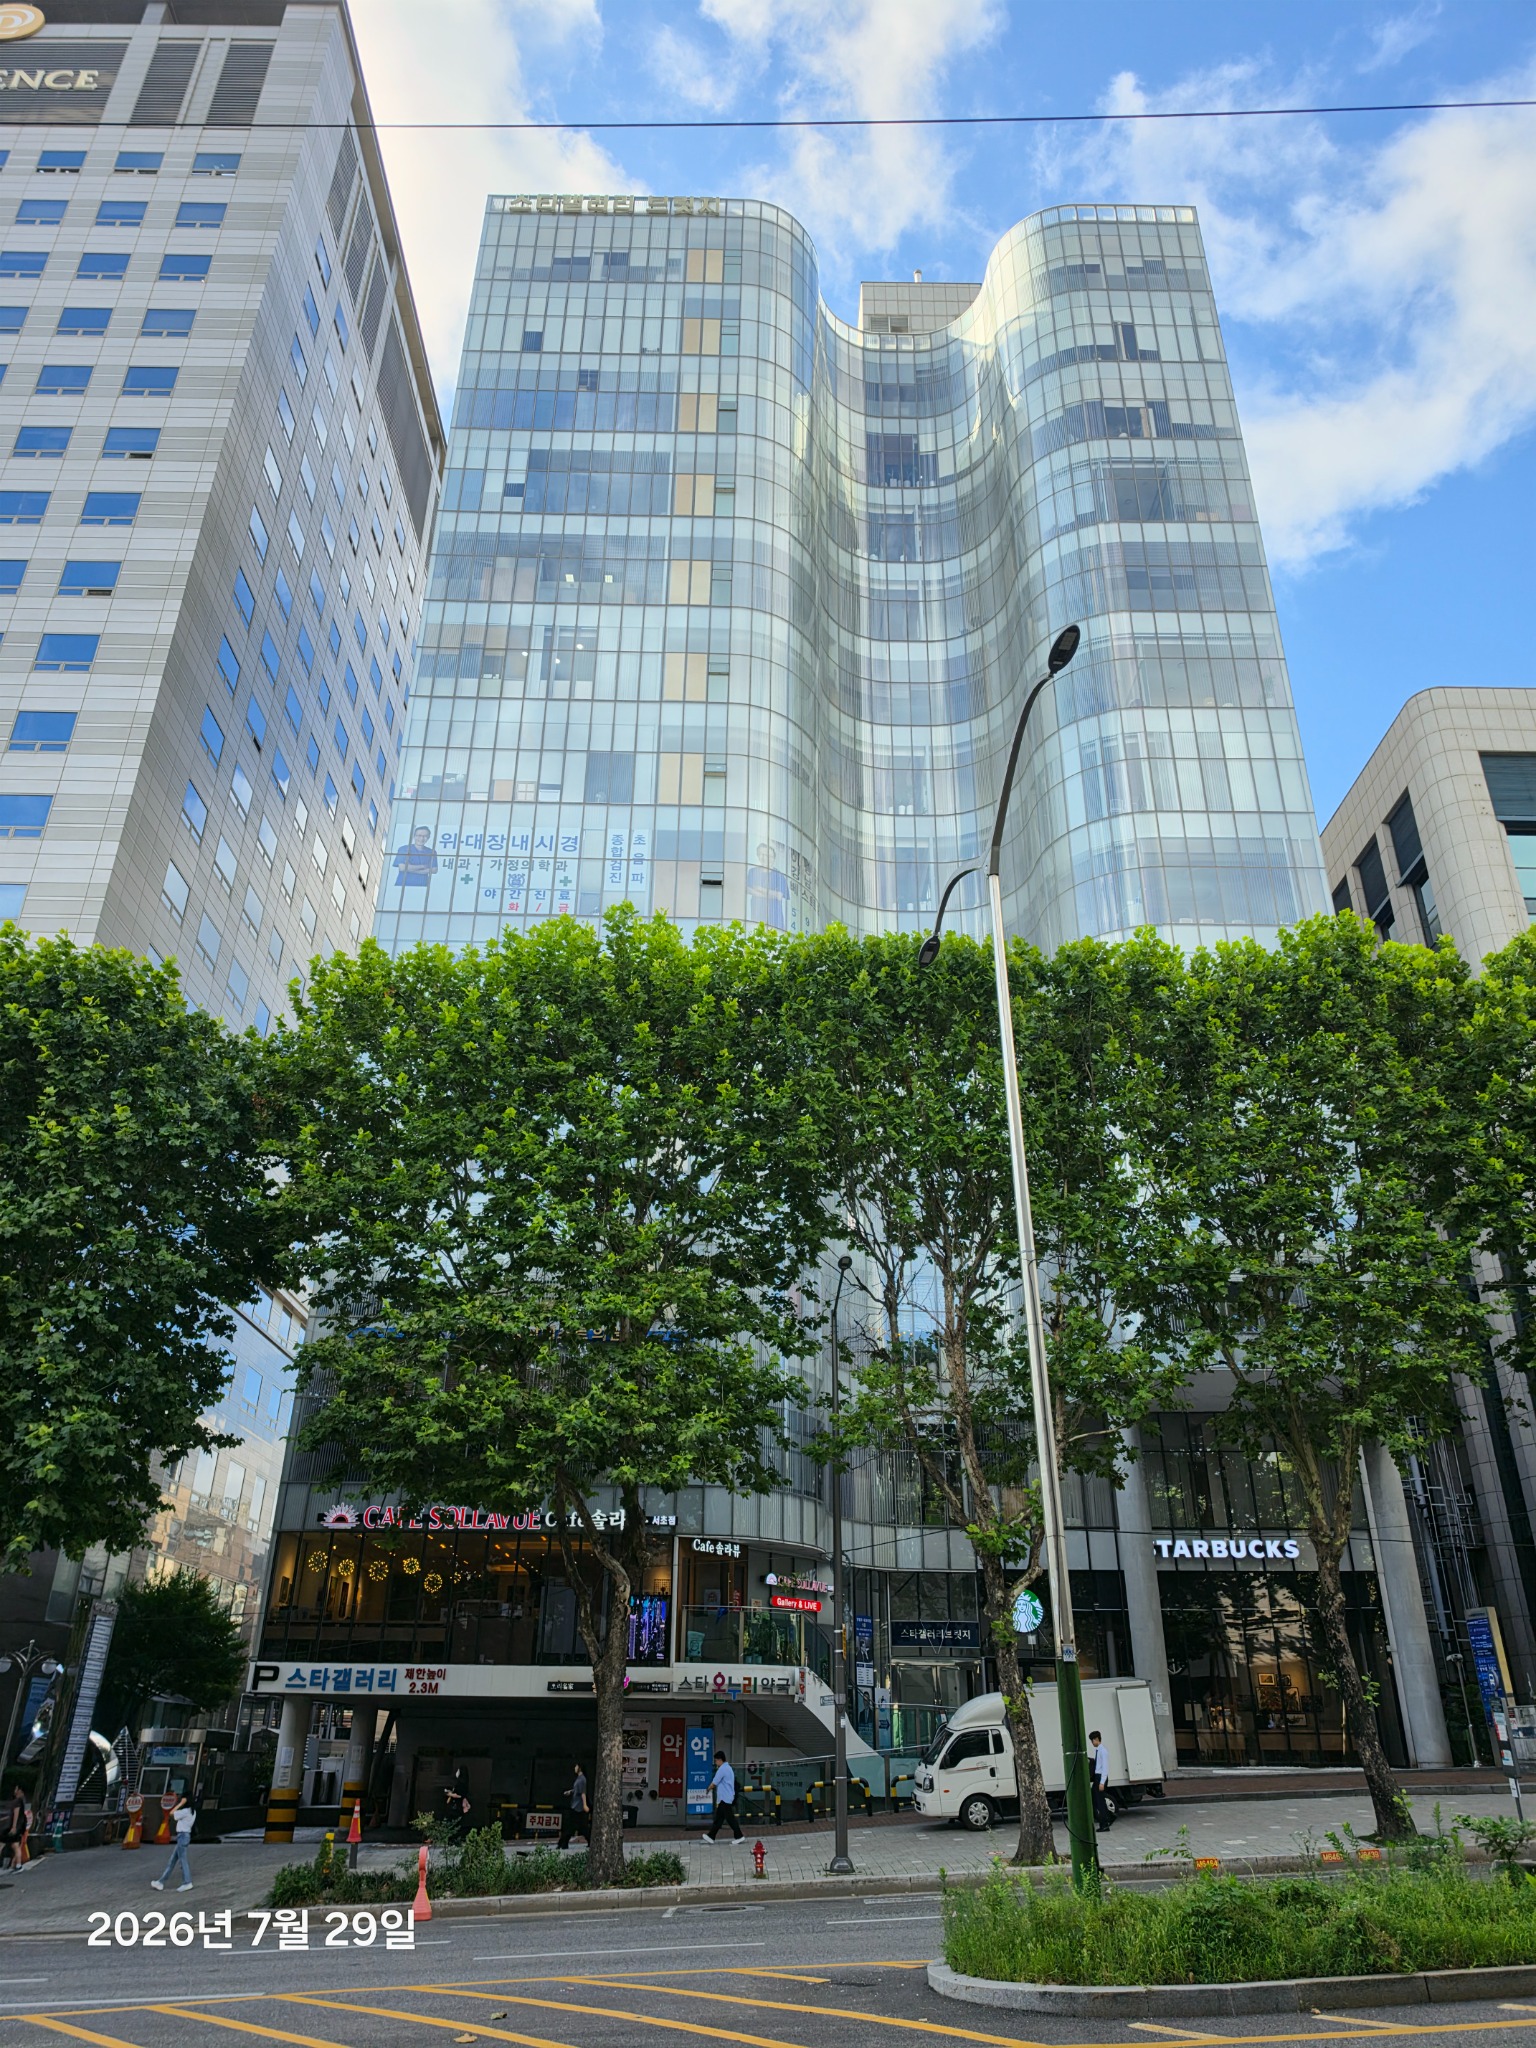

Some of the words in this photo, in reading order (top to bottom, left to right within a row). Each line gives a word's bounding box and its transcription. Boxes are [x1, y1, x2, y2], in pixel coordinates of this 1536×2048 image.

[509, 194, 635, 215] 스타갤러리
[646, 195, 720, 217] 브릿지
[652, 1515, 677, 1527] 서초점
[693, 1538, 715, 1554] Cafe
[715, 1542, 742, 1558] 솔라뷰
[1152, 1539, 1300, 1559] TARBUCKS
[776, 1597, 797, 1609] Gallery
[798, 1600, 803, 1609] &
[804, 1601, 817, 1610] LIVE
[252, 1665, 280, 1691] P
[285, 1667, 398, 1692] 스타갤러리
[404, 1667, 447, 1681] 제한높이
[409, 1682, 439, 1694] 2.3M
[663, 1734, 683, 1758] 약
[691, 1736, 710, 1761] 약
[695, 1805, 705, 1813] B1
[529, 1815, 560, 1827] 주차금지
